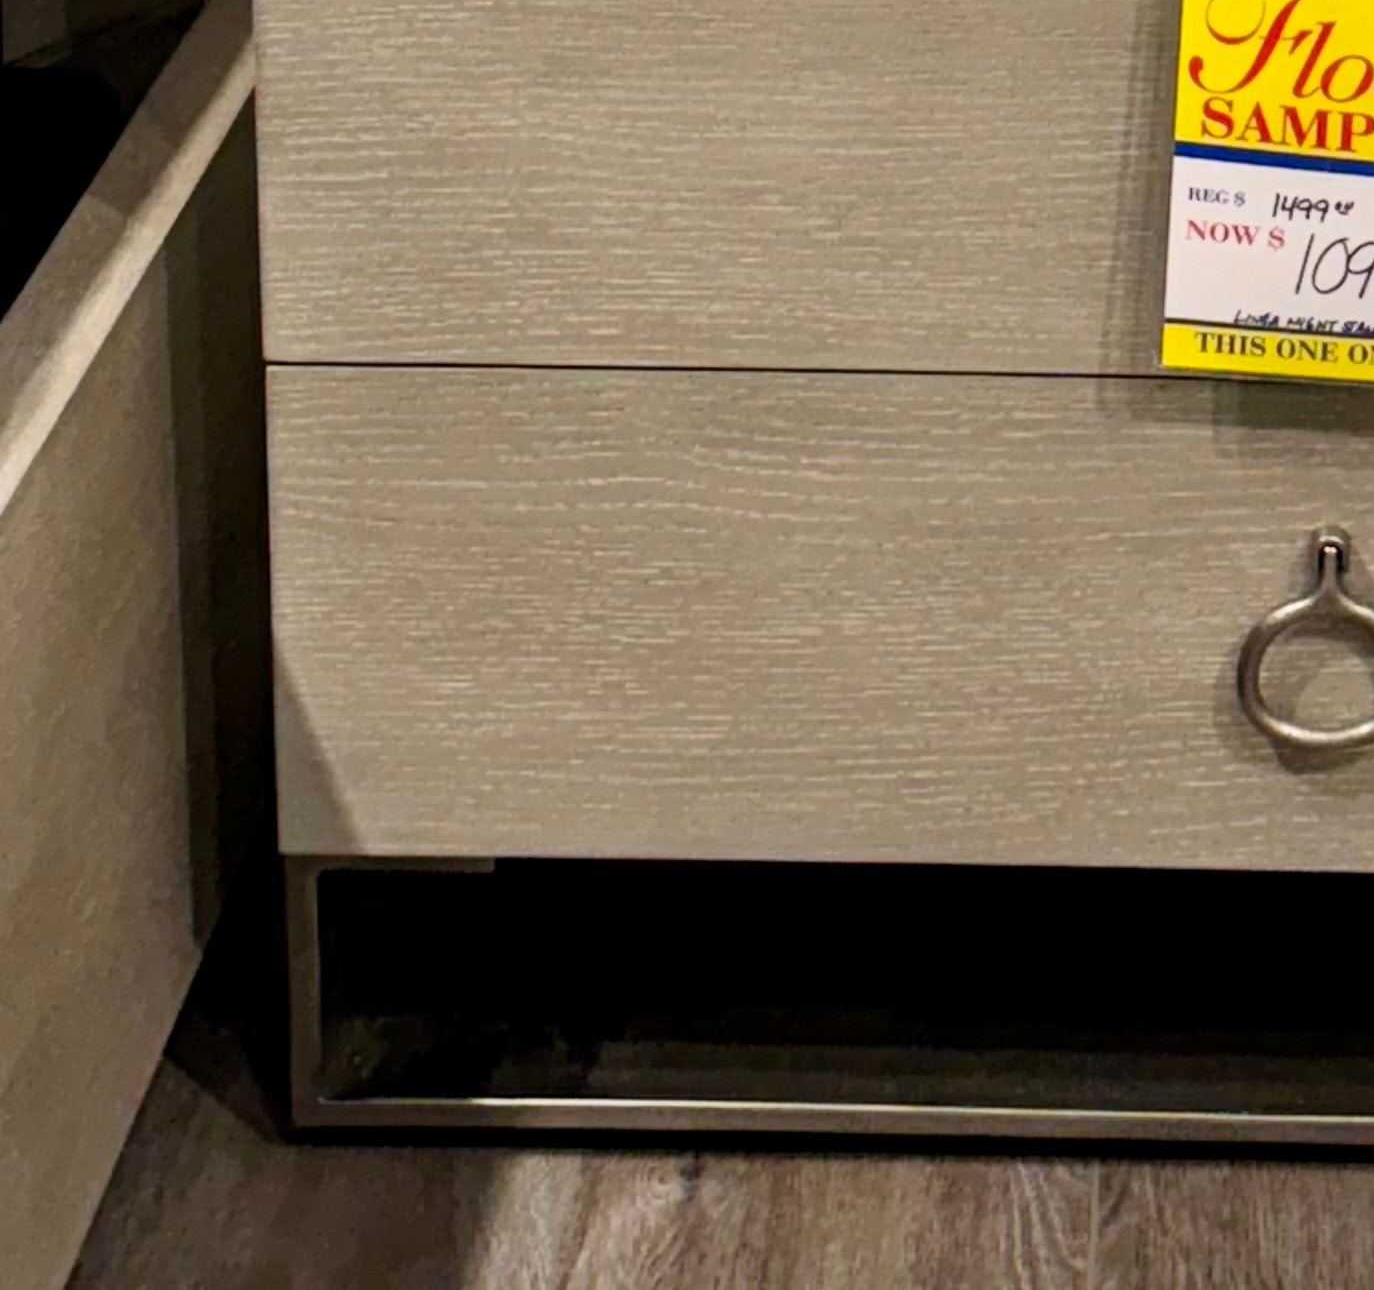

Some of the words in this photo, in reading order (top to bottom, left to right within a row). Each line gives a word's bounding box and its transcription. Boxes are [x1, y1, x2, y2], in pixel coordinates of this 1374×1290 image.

[1187, 186, 1230, 205] REG
[1185, 219, 1261, 247] NOW
[1194, 331, 1268, 357] THIS
[1275, 337, 1340, 364] ONE
